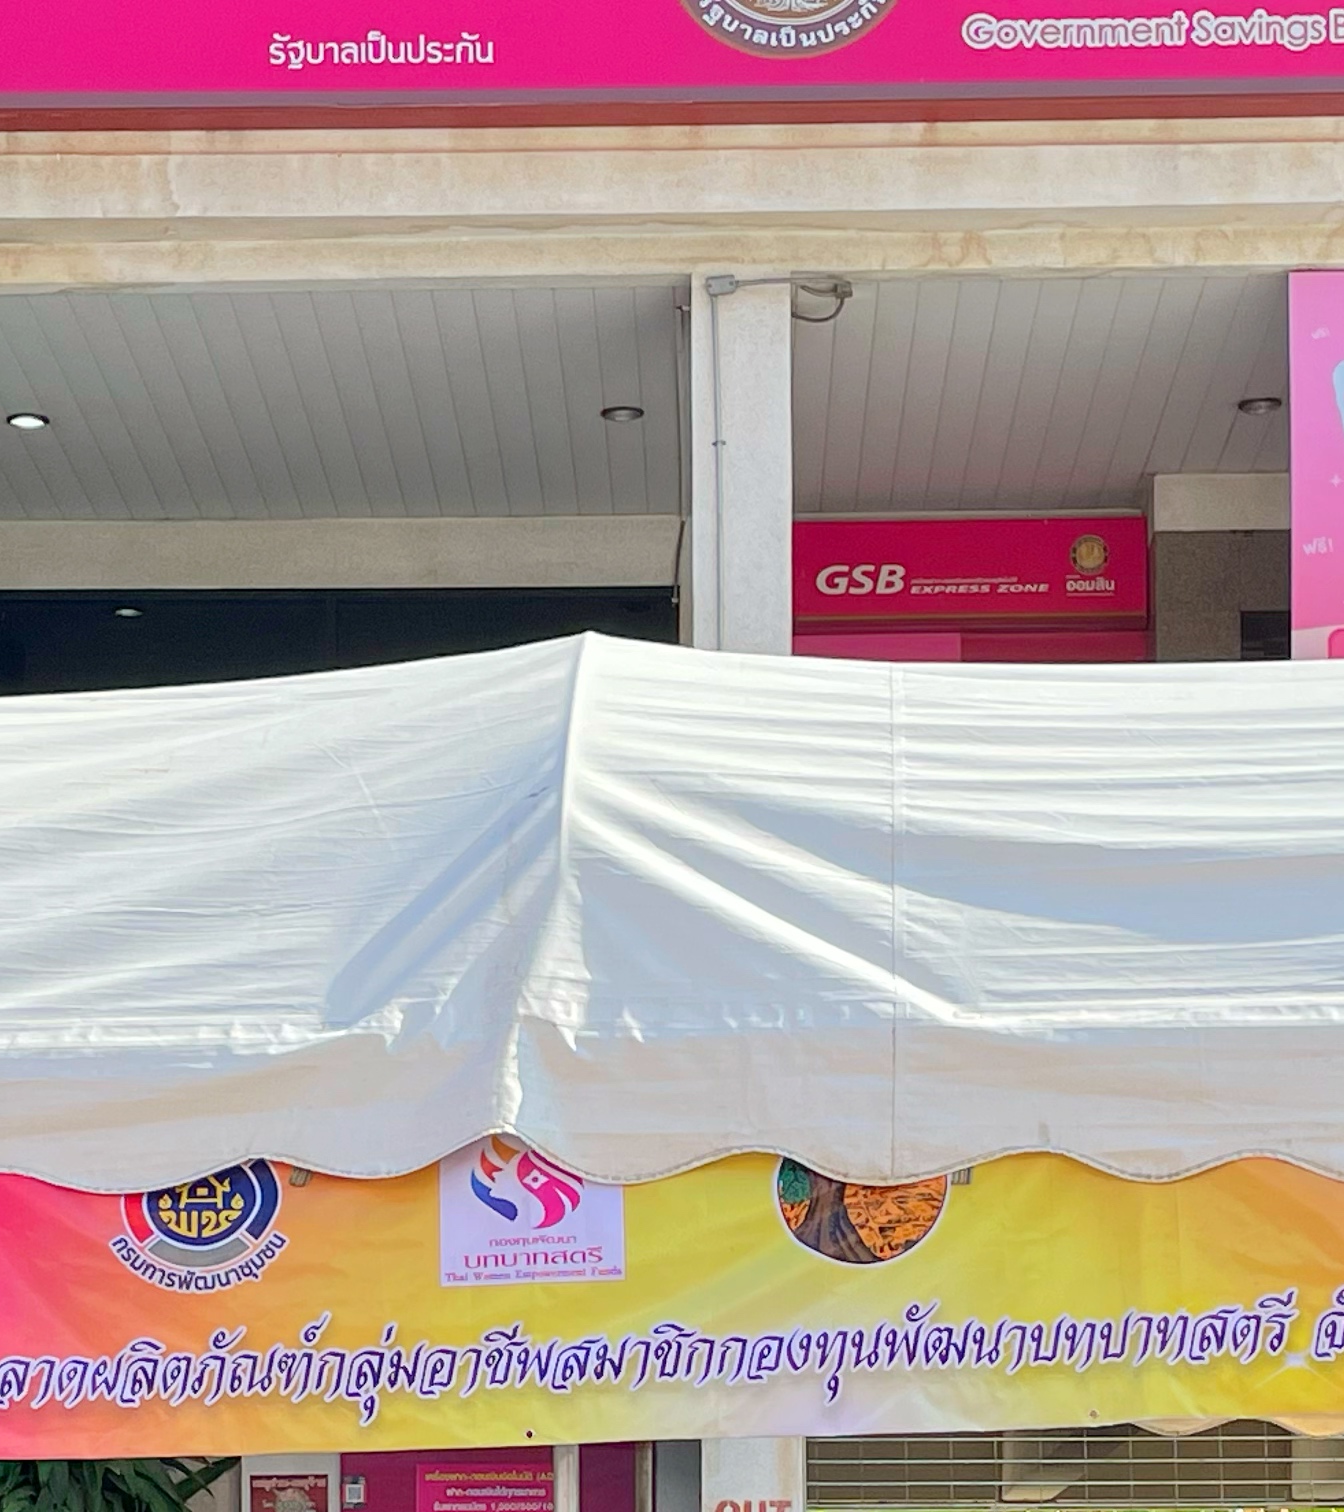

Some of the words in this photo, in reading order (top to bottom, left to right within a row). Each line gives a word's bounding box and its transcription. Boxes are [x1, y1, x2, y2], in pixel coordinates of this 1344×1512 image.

[962, 13, 1185, 49] Government
[1190, 10, 1323, 50] Savings
[268, 31, 495, 69] รัฐบาลเป็นประกัน
[816, 563, 906, 595] GSB
[910, 584, 990, 594] EXPRESS
[997, 583, 1050, 593] ZONE
[1066, 577, 1115, 591] ออมสิน
[110, 1233, 288, 1291] กรมการพัฒนาชุมชน
[464, 1246, 603, 1269] บทบาทสตรี
[445, 1272, 468, 1282] Thai
